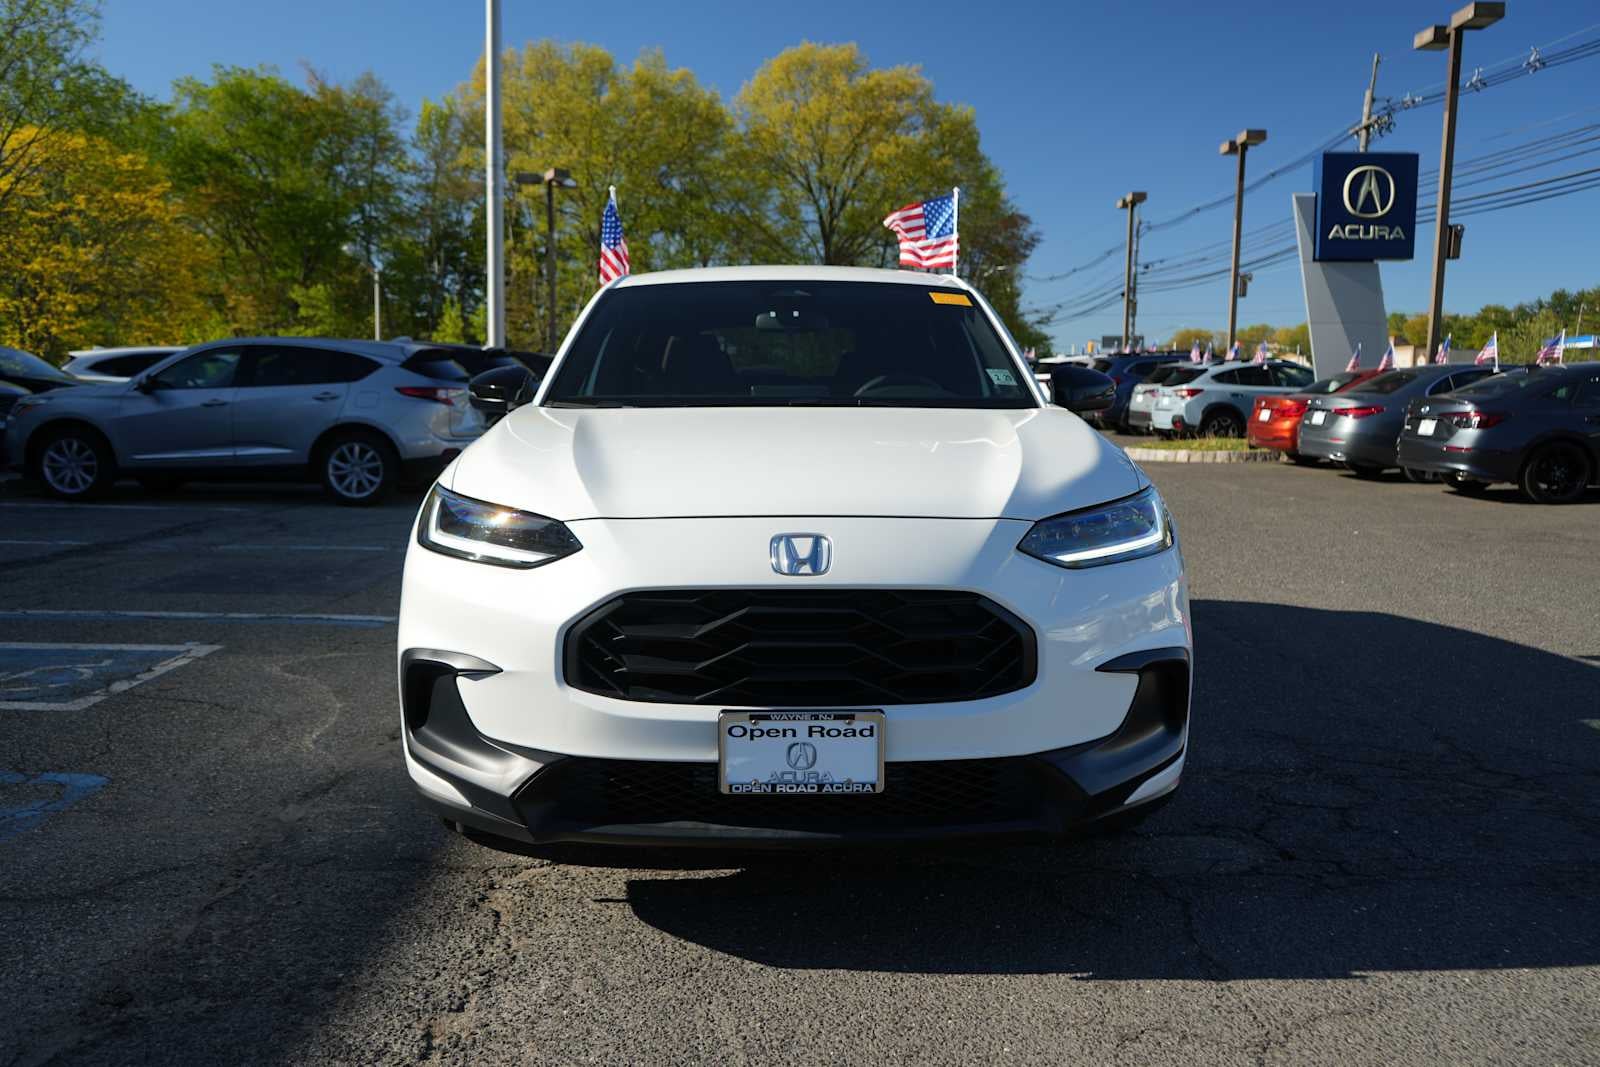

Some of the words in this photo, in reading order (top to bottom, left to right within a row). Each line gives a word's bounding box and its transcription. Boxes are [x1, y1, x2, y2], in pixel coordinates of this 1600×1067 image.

[1328, 224, 1405, 240] ACURA
[727, 725, 797, 740] Open
[807, 725, 874, 738] Road
[768, 770, 834, 783] ACURA
[732, 784, 772, 793] OPEN
[776, 784, 818, 793] ROAD
[822, 784, 873, 793] ACURA
